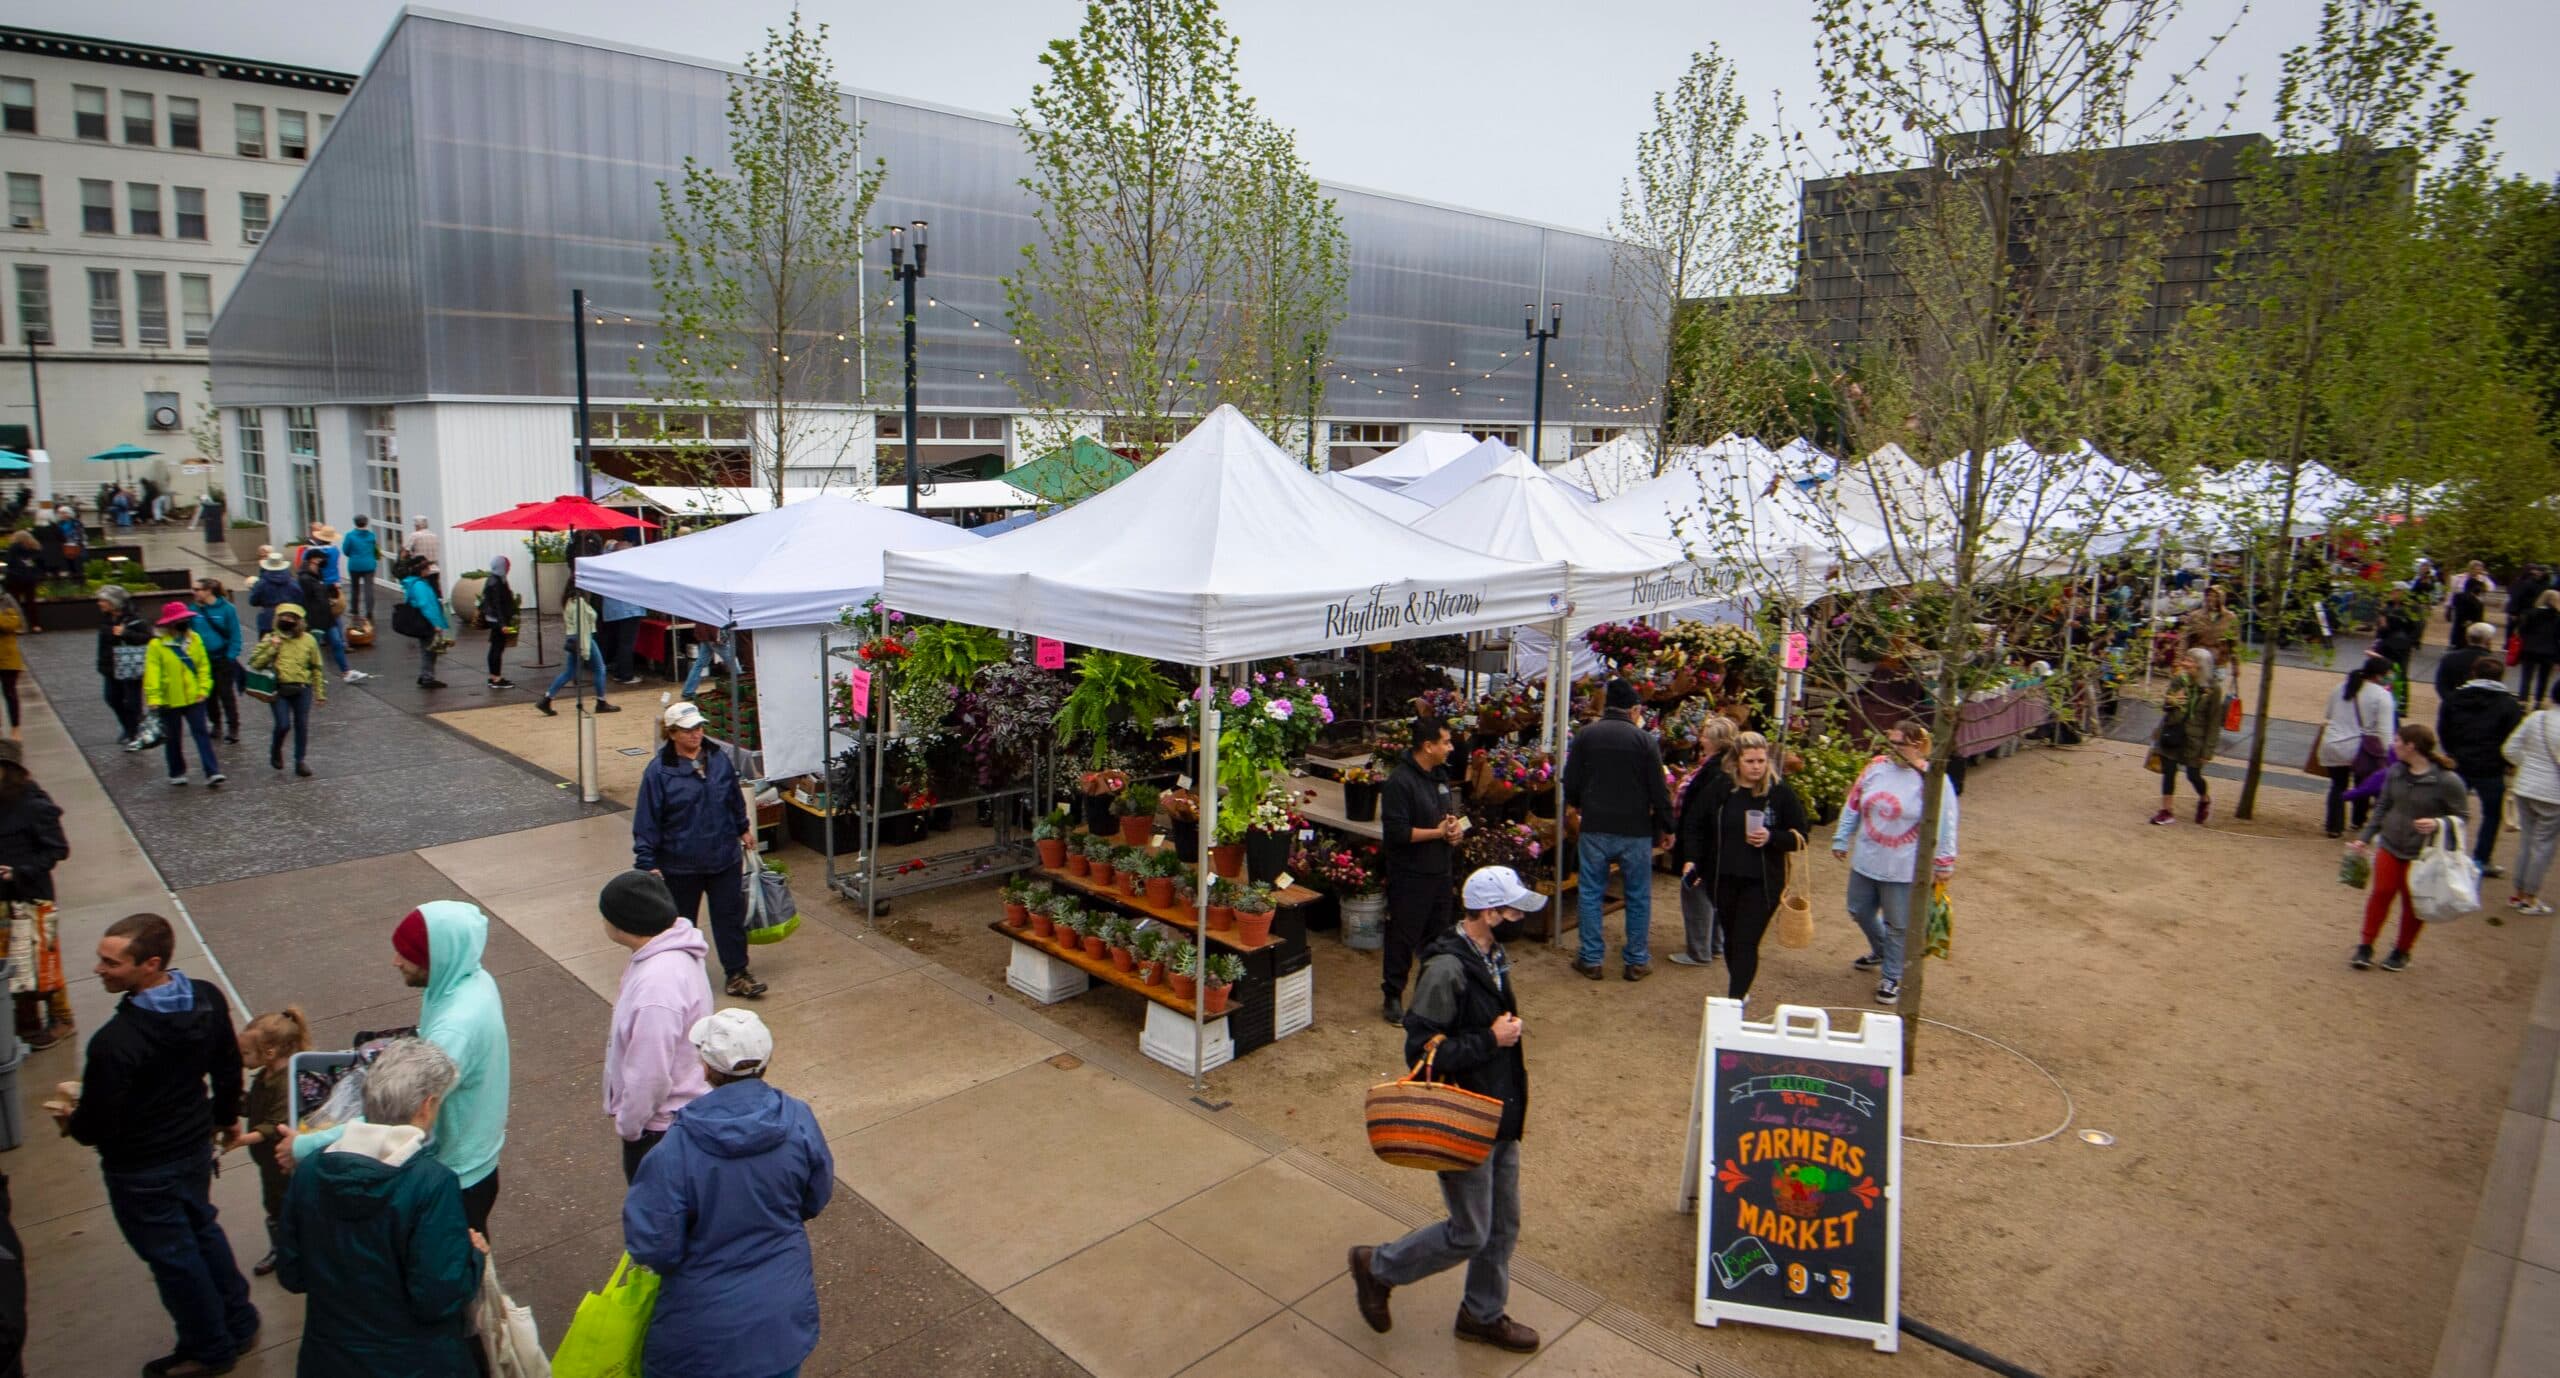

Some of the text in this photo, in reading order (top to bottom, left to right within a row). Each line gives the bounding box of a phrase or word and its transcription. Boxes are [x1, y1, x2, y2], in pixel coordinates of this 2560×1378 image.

[1632, 561, 1685, 610] Rhythm
[1688, 568, 1704, 597] &
[1325, 583, 1487, 643] Rhythm & Blooms
[1769, 1076, 1828, 1095] WELCOME
[1738, 1127, 1865, 1177] FARMERS
[1737, 1197, 1859, 1251] MARKET
[1788, 1262, 1808, 1294] 9
[1830, 1269, 1851, 1300] 3
